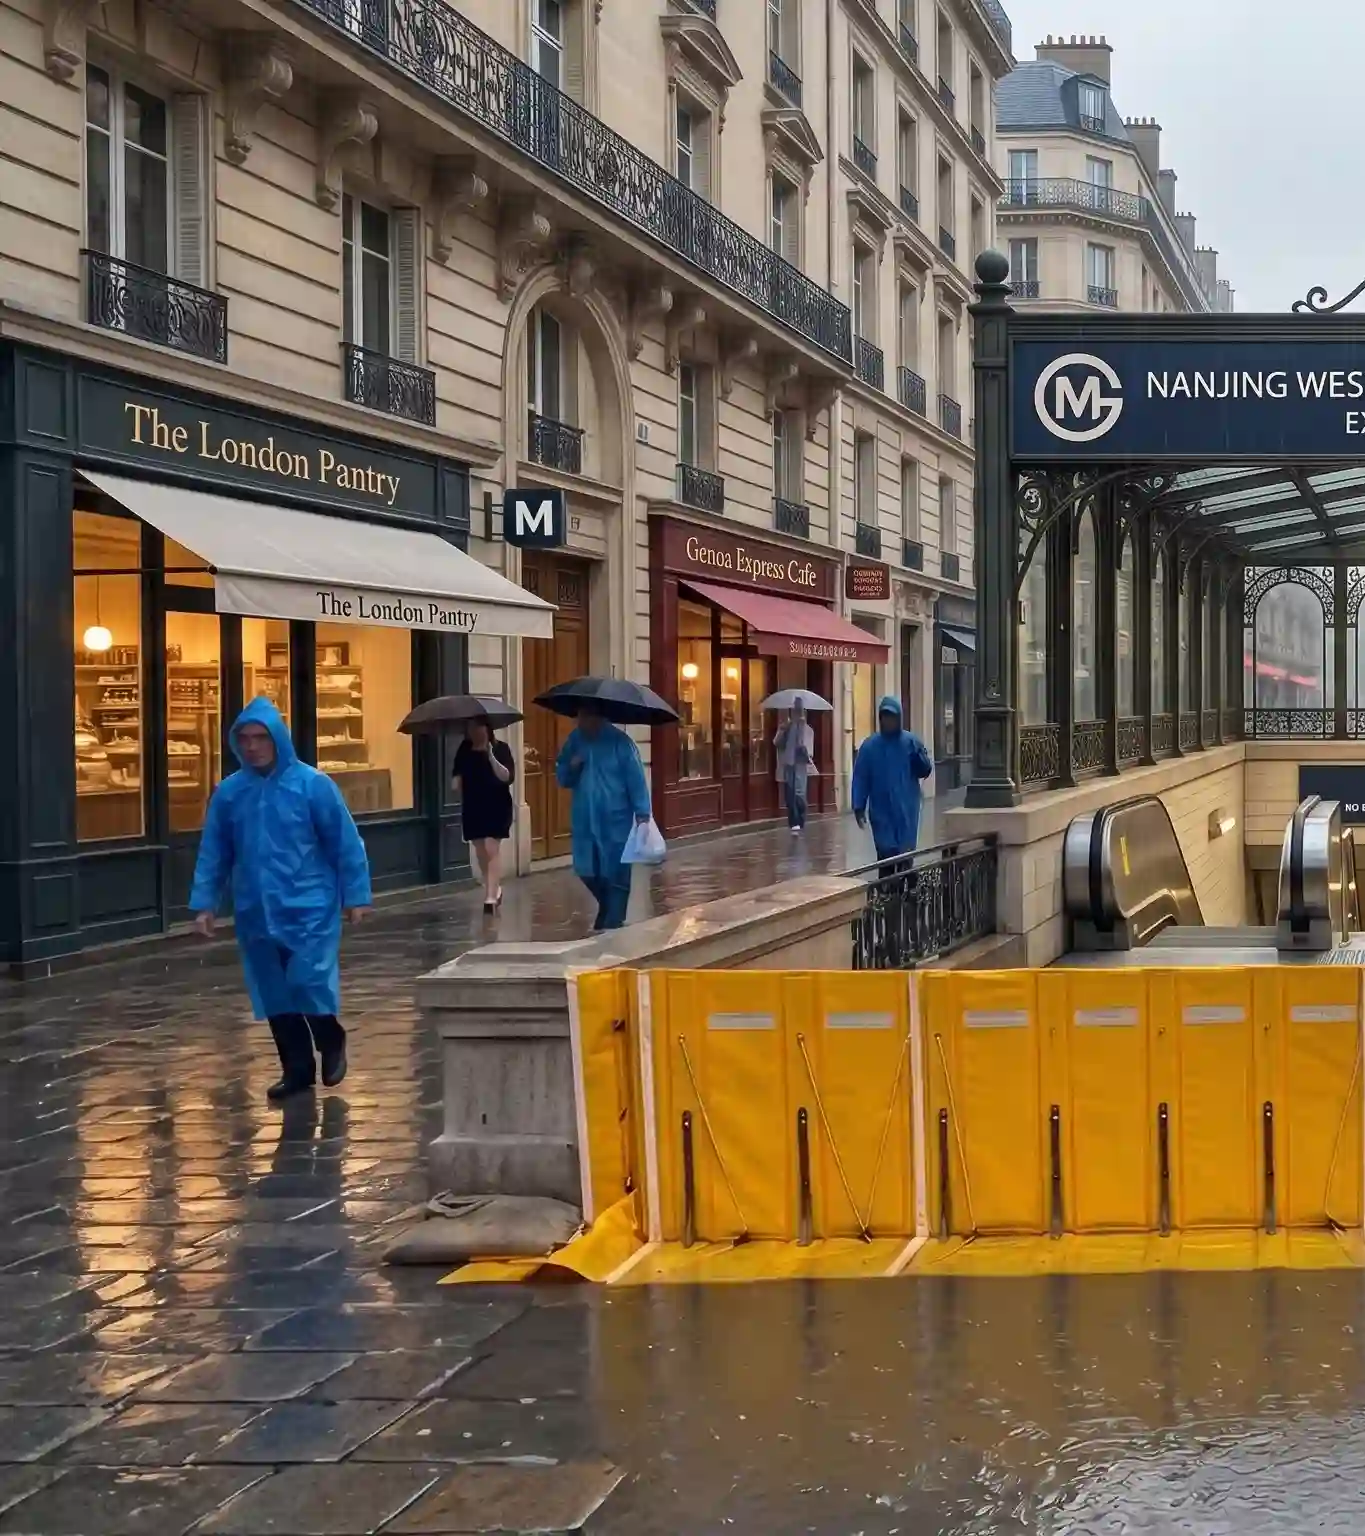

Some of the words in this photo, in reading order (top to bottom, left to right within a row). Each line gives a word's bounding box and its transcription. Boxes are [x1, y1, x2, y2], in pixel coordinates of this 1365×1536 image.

[1147, 371, 1288, 399] NANJING
[124, 402, 189, 453] The
[198, 420, 311, 480] London
[318, 449, 401, 506] Pantry
[515, 499, 553, 537] M
[686, 536, 733, 569] Genoa
[735, 547, 785, 582] Express
[787, 559, 817, 587] Cafe
[315, 591, 352, 618] The
[357, 595, 424, 624] London
[428, 603, 479, 633] Pantry
[1345, 803, 1360, 812] NO
